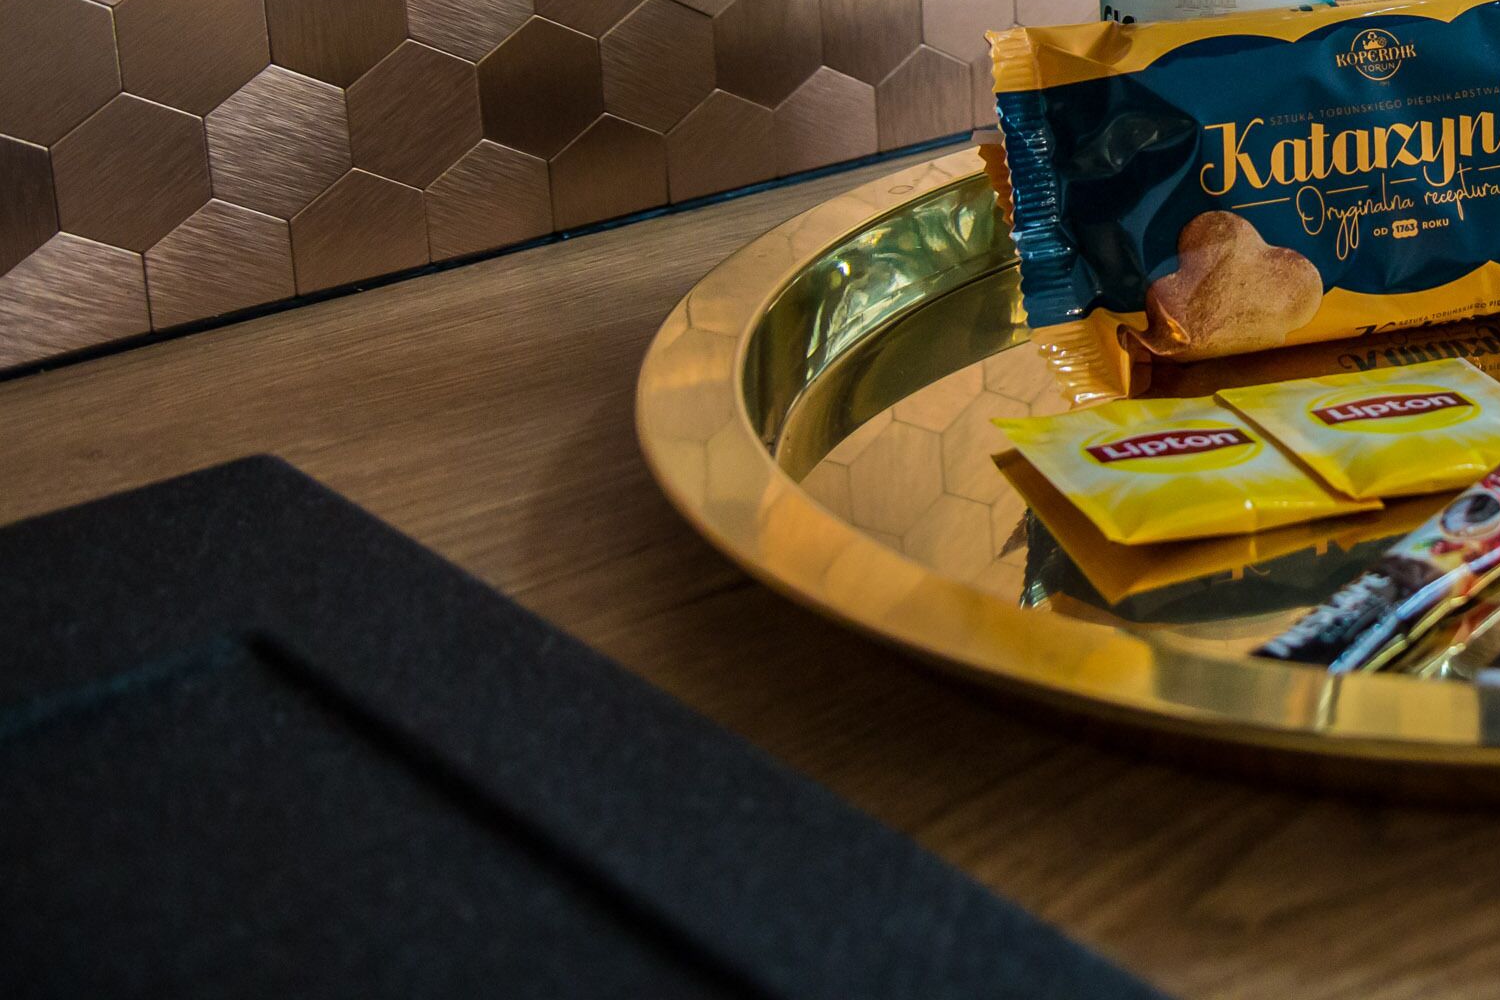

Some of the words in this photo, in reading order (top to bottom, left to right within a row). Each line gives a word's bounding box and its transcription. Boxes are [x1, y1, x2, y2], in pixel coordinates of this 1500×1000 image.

[1335, 43, 1417, 68] KOPERNIK
[1269, 112, 1315, 127] SZTUKA
[1295, 171, 1415, 261] Oryginalna
[1373, 227, 1389, 237] OD
[1395, 222, 1416, 233] 1763
[1422, 218, 1449, 230] ROKU
[1326, 393, 1458, 422] Lipton
[1102, 430, 1240, 460] Lipton
